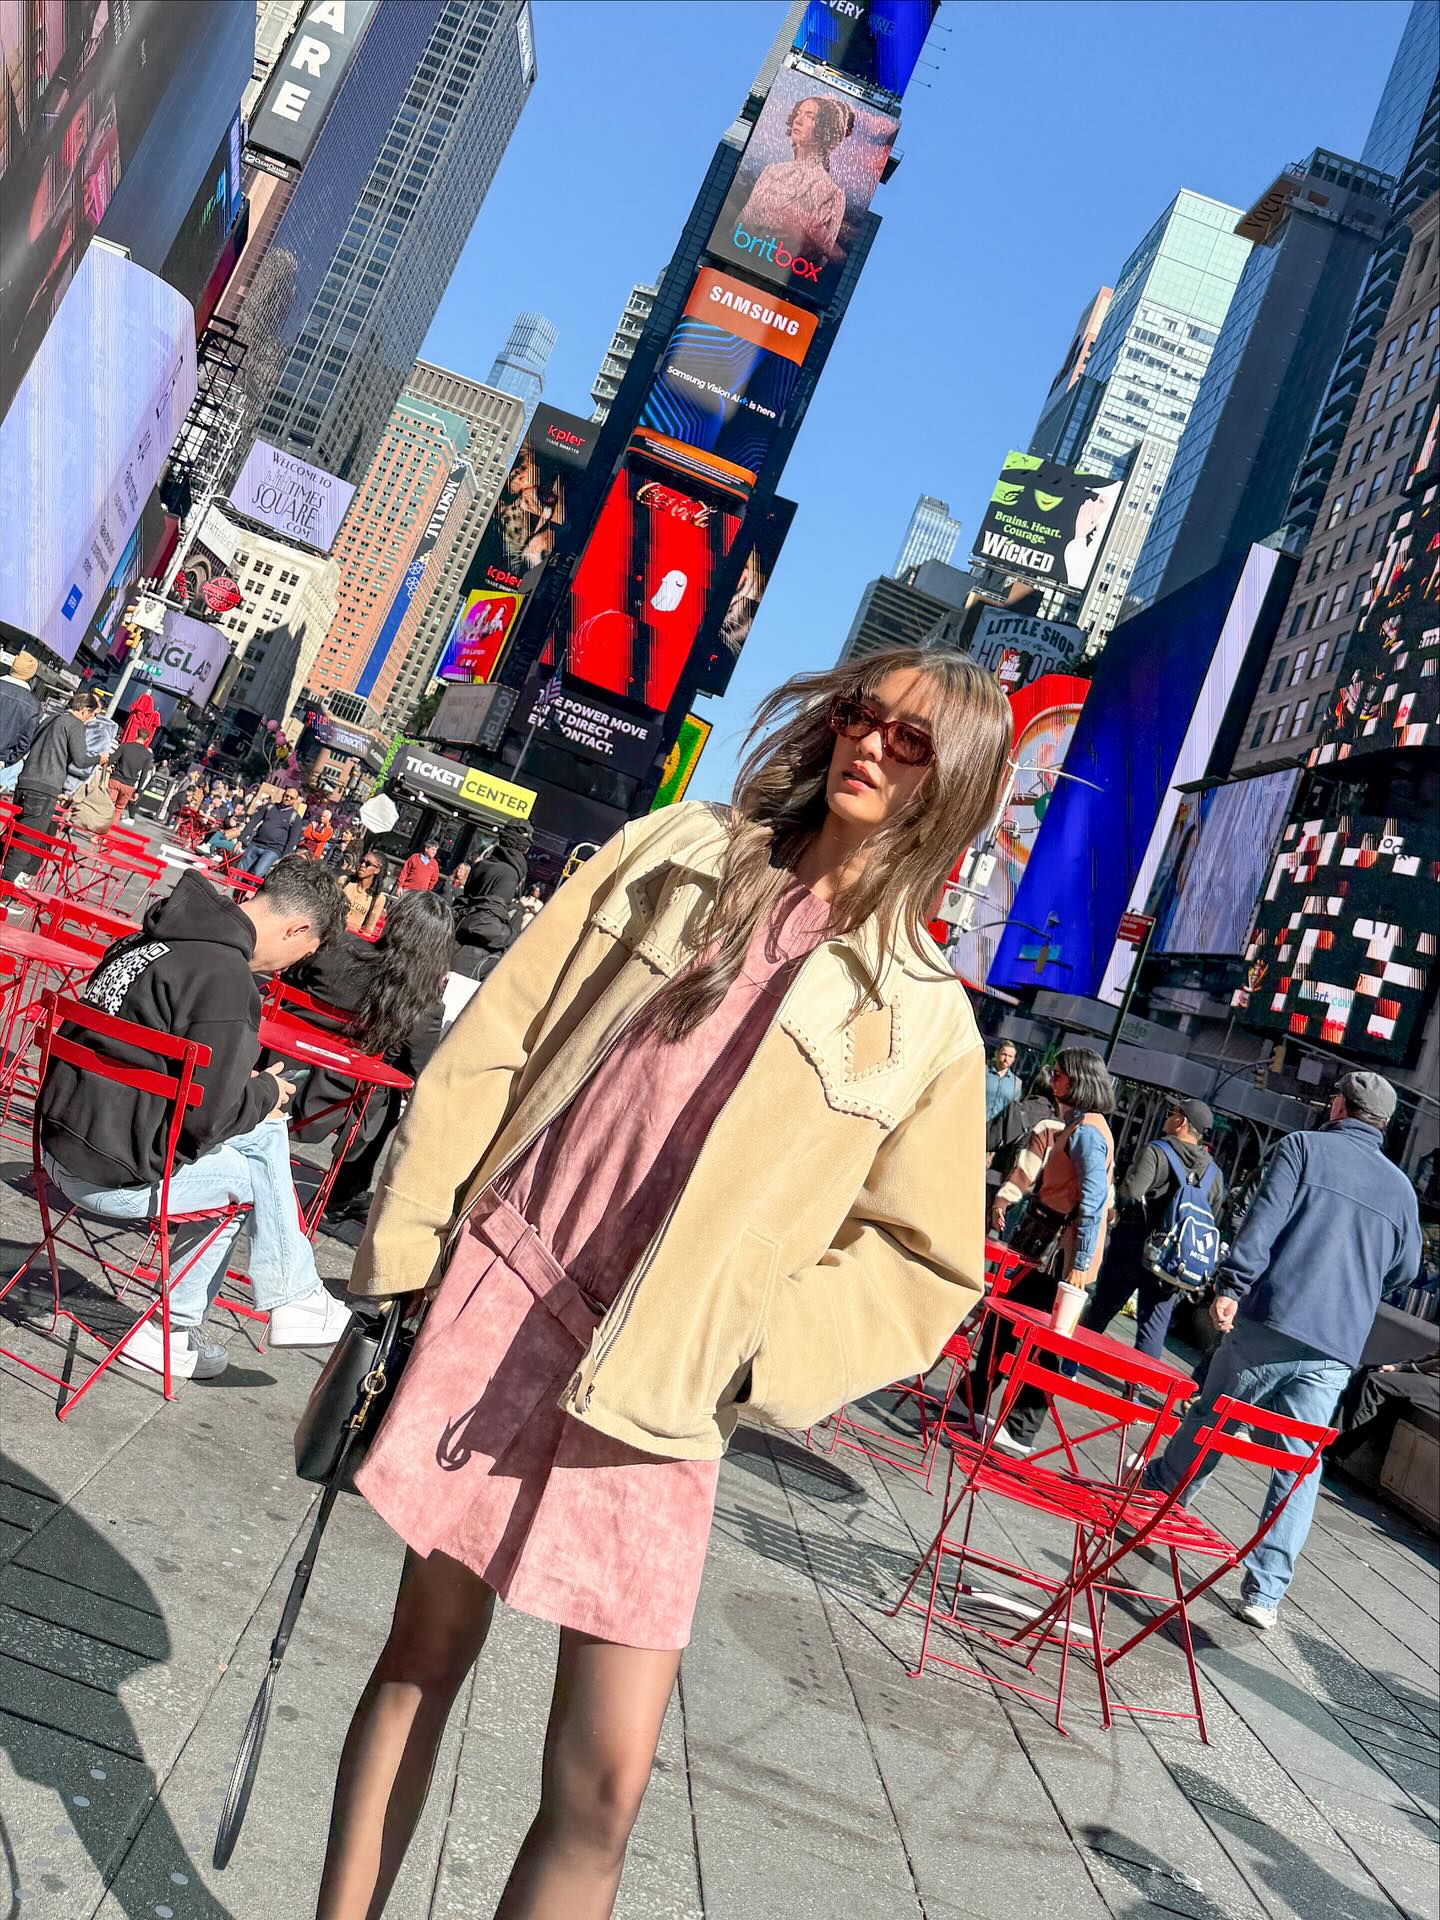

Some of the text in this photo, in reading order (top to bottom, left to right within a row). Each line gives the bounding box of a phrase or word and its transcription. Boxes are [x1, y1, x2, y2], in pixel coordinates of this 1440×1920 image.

[821, 0, 864, 20] VERY
[733, 222, 822, 284] britbox
[710, 285, 800, 336] SAMSUNG
[667, 365, 706, 390] Samsung
[707, 382, 731, 399] Vision
[749, 400, 757, 411] is
[757, 404, 776, 419] here
[272, 451, 332, 489] WELCOME TO
[252, 484, 319, 530] SQUARE
[288, 480, 325, 509] TIMES
[283, 521, 311, 539] .COM
[995, 511, 1062, 539] Brains. Heart.
[1003, 524, 1046, 545] Courage.
[986, 618, 1075, 659] LITTLE SHOP
[527, 713, 613, 755] EY ONTACT.
[564, 698, 609, 726] POWER
[609, 717, 648, 740] MOVE
[566, 713, 613, 739] DIRECT
[406, 755, 465, 790] TICKET
[465, 780, 529, 814] CENTER
